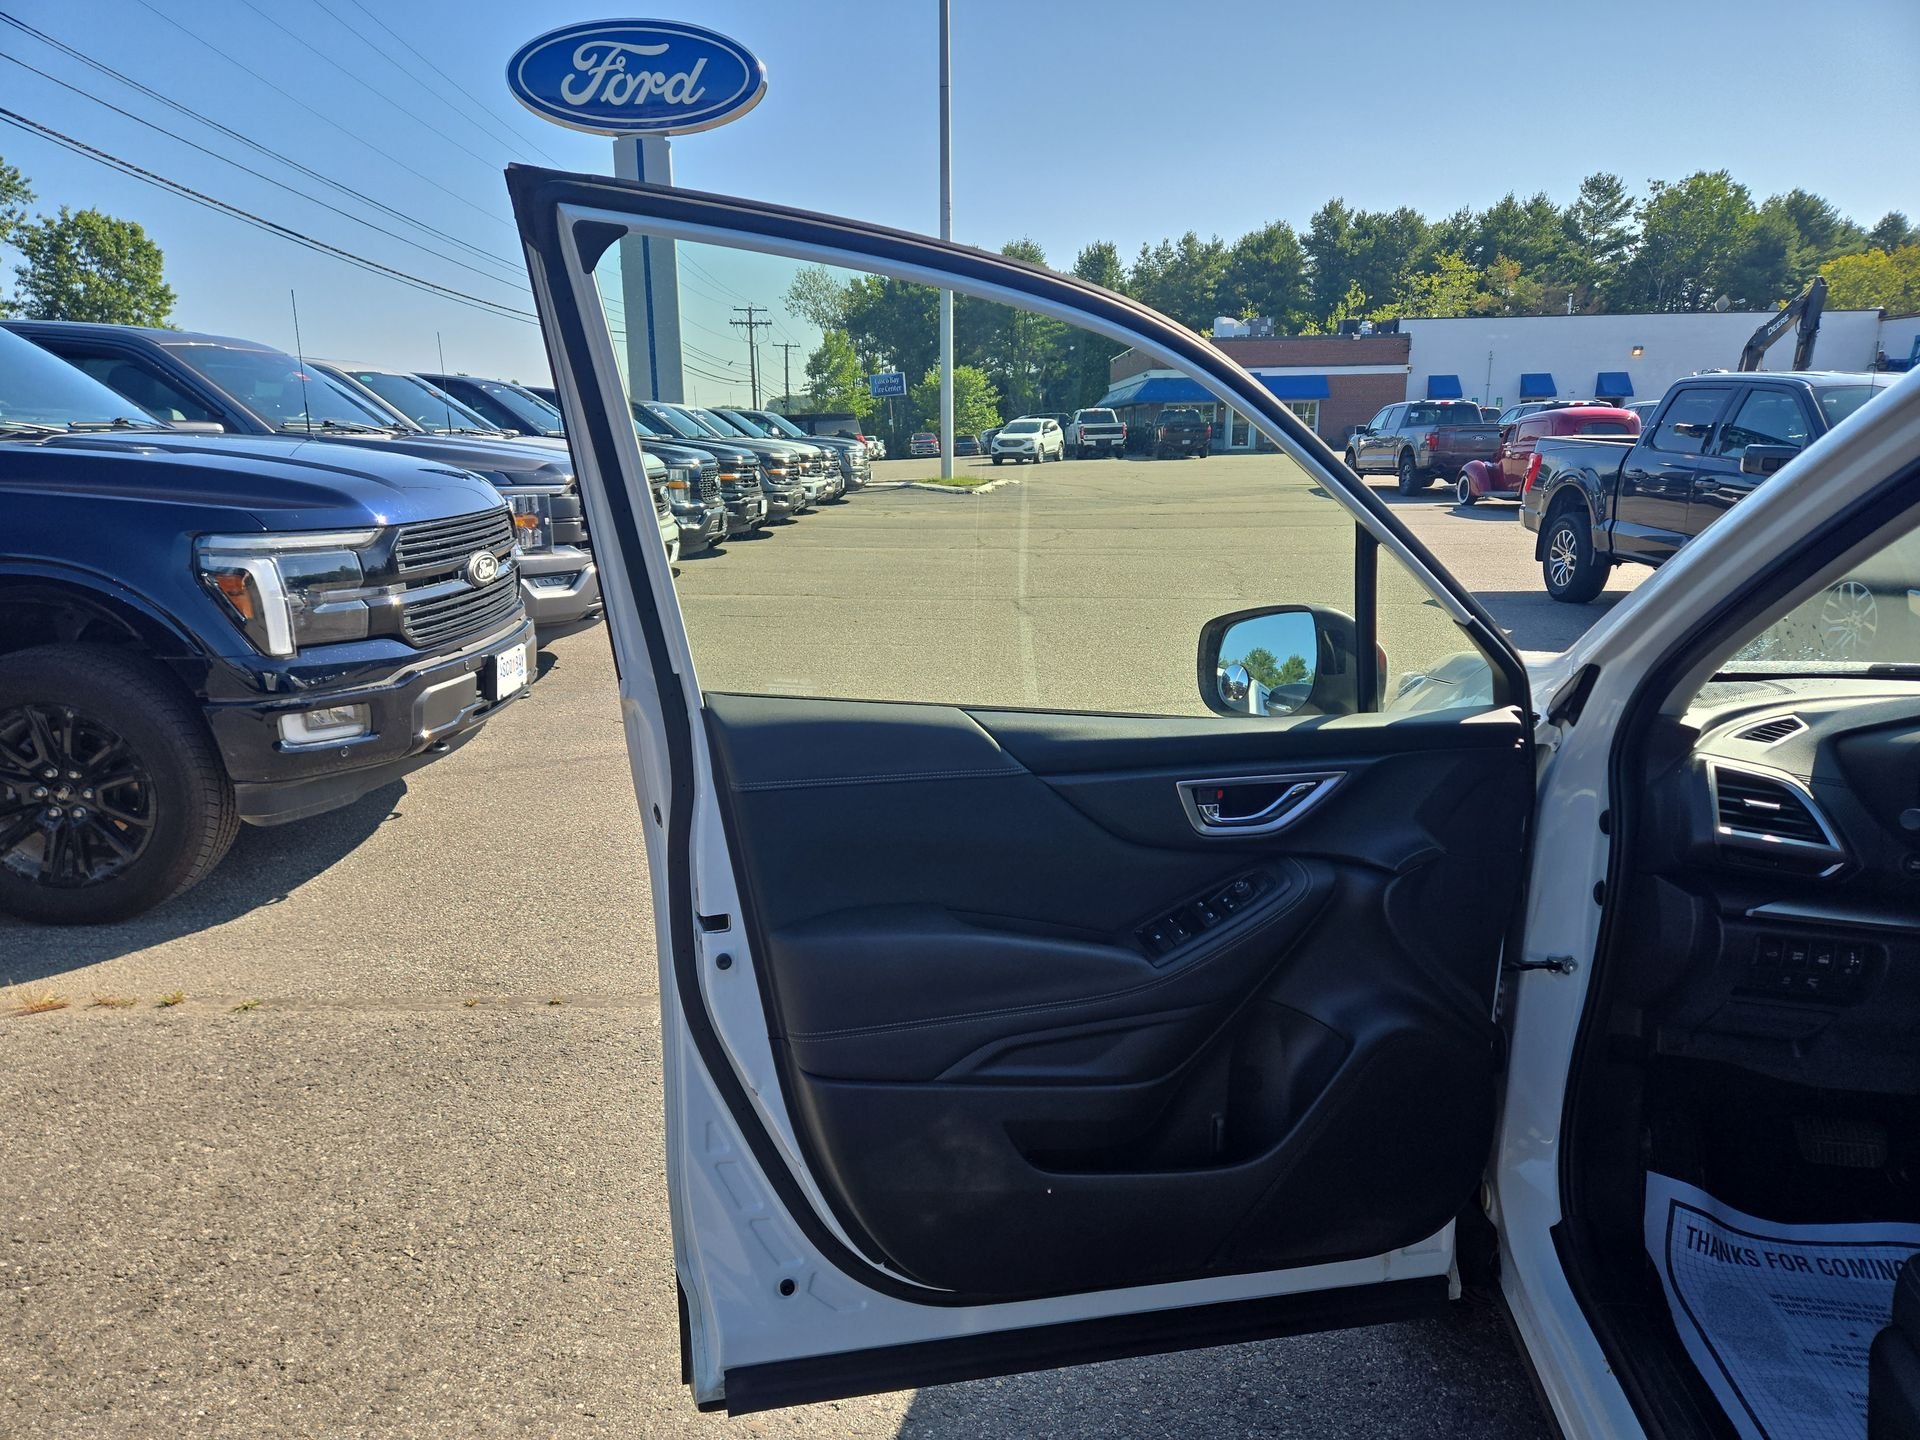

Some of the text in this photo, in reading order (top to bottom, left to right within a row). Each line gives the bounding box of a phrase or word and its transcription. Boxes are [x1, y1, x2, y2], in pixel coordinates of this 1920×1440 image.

[560, 40, 708, 106] Ford
[1767, 313, 1790, 337] DEERE
[1686, 1225, 1761, 1267] THANKS
[1764, 1251, 1814, 1274] FOR
